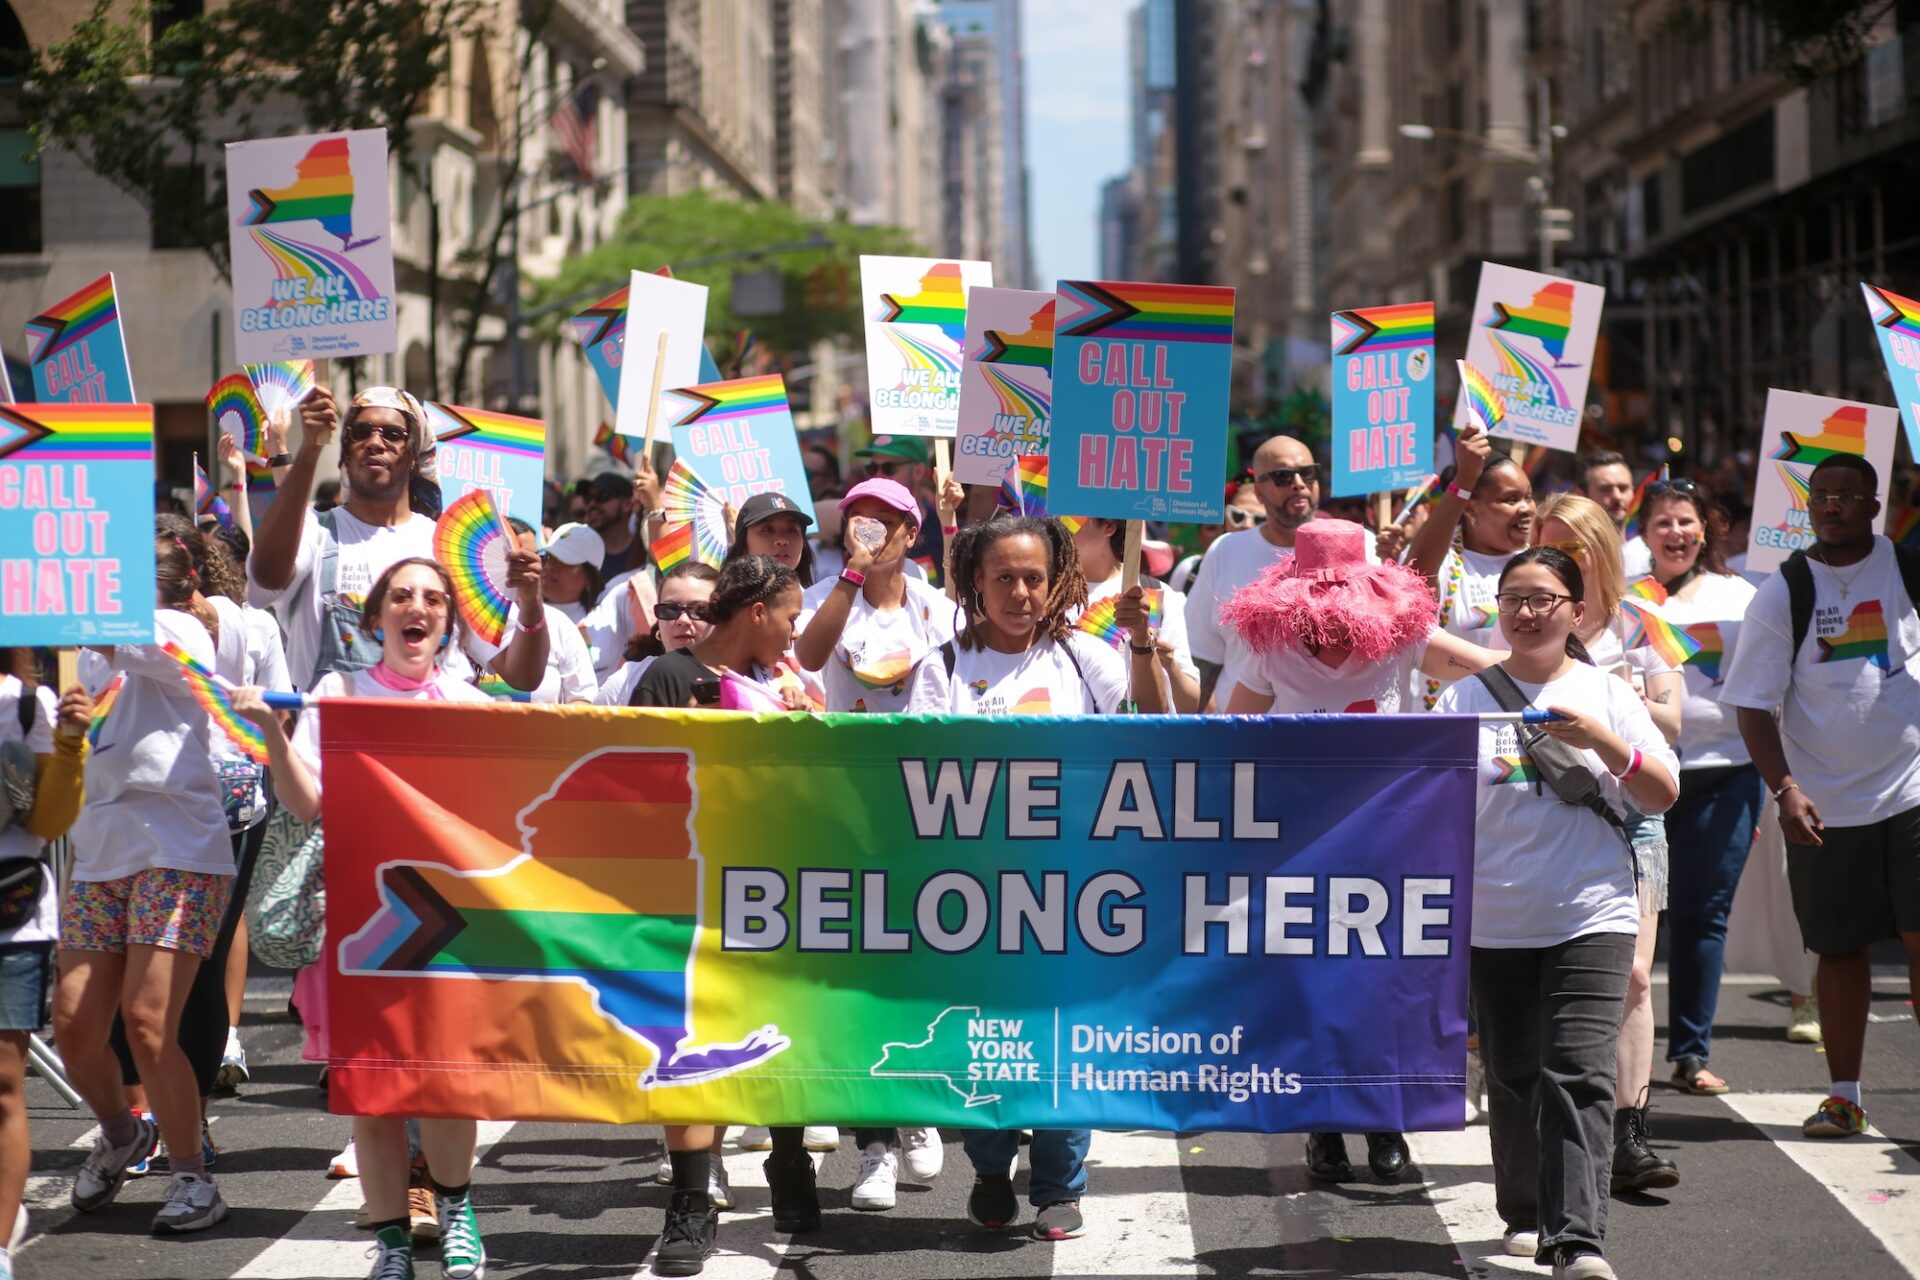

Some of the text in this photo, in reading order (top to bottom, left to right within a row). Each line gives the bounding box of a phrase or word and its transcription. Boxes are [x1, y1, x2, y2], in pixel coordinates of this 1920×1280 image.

[272, 274, 348, 301] WE ALL
[241, 296, 389, 332] BELONG HERE
[45, 341, 97, 396] CALL
[1078, 341, 1174, 389] CALL
[1888, 333, 1920, 371] CA
[902, 368, 931, 387] WE
[1347, 352, 1403, 392] CALL
[1493, 373, 1551, 401] WE ALL
[875, 388, 947, 410] BELONG
[1112, 389, 1187, 435] OUT
[1368, 387, 1411, 425] OUT
[1531, 403, 1578, 427] HERE
[688, 420, 759, 456] CALL
[994, 413, 1050, 437] WE AL
[961, 434, 1041, 458] BELONG
[1077, 433, 1194, 493] HATE
[1349, 422, 1416, 473] HATE
[439, 446, 504, 486] CALL
[720, 448, 772, 484] OUT
[0, 464, 95, 509] CALL
[33, 511, 109, 555] OUT
[1755, 526, 1817, 549] BELON
[2, 558, 122, 616] HATE
[898, 757, 1282, 842] WE ALL
[721, 866, 1456, 959] BELONG HERE
[968, 1018, 1024, 1039] NEW
[1071, 1024, 1244, 1055] Division of
[967, 1040, 1034, 1060] YORK
[967, 1061, 1041, 1082] STATE
[1071, 1063, 1303, 1103] Human Rights
